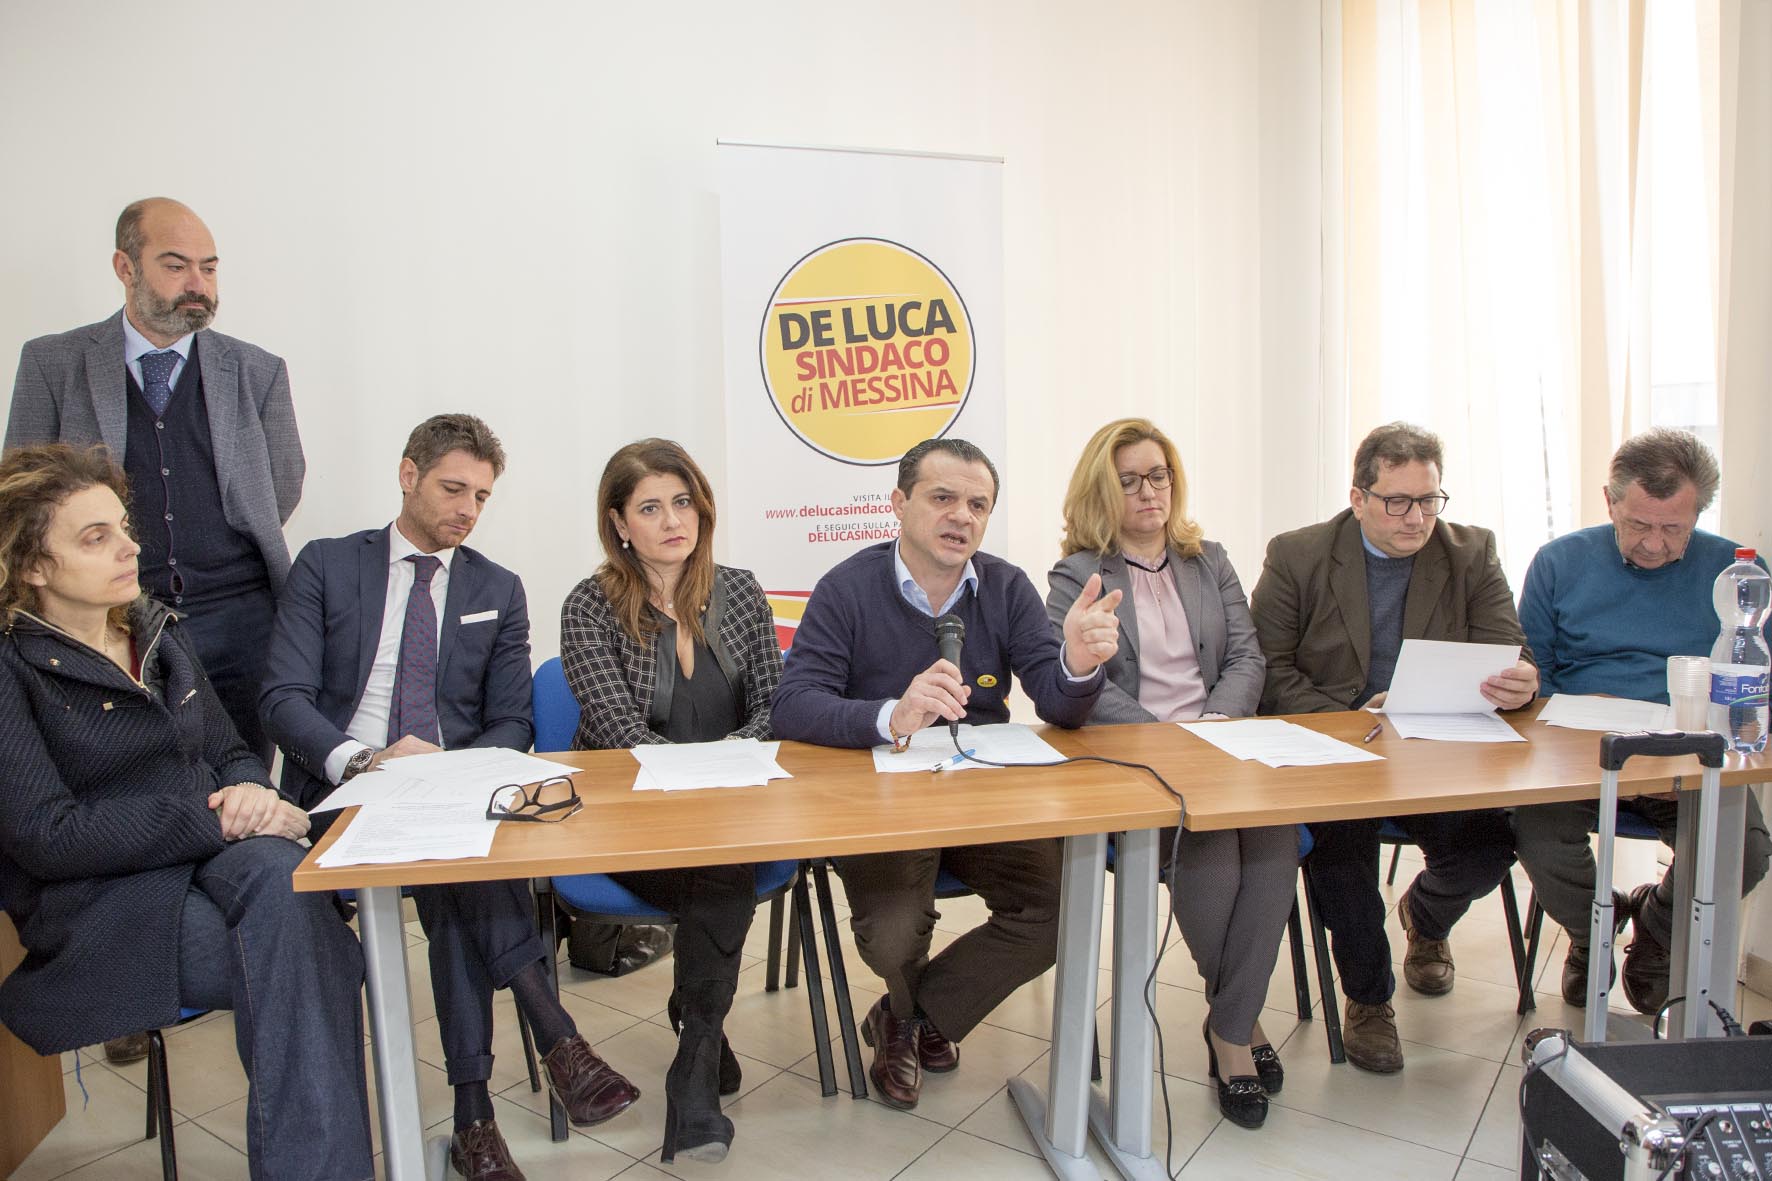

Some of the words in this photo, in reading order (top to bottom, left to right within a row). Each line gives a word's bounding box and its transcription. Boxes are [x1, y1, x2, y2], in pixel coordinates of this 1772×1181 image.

[779, 310, 835, 350] DE
[842, 299, 957, 343] LUCA
[796, 338, 949, 380] SINDACO
[791, 387, 812, 413] di
[819, 369, 957, 409] MESSINA
[853, 494, 881, 502] VISITA
[816, 524, 821, 532] E
[824, 523, 860, 531] SEGUICI
[863, 521, 890, 530] SULLA
